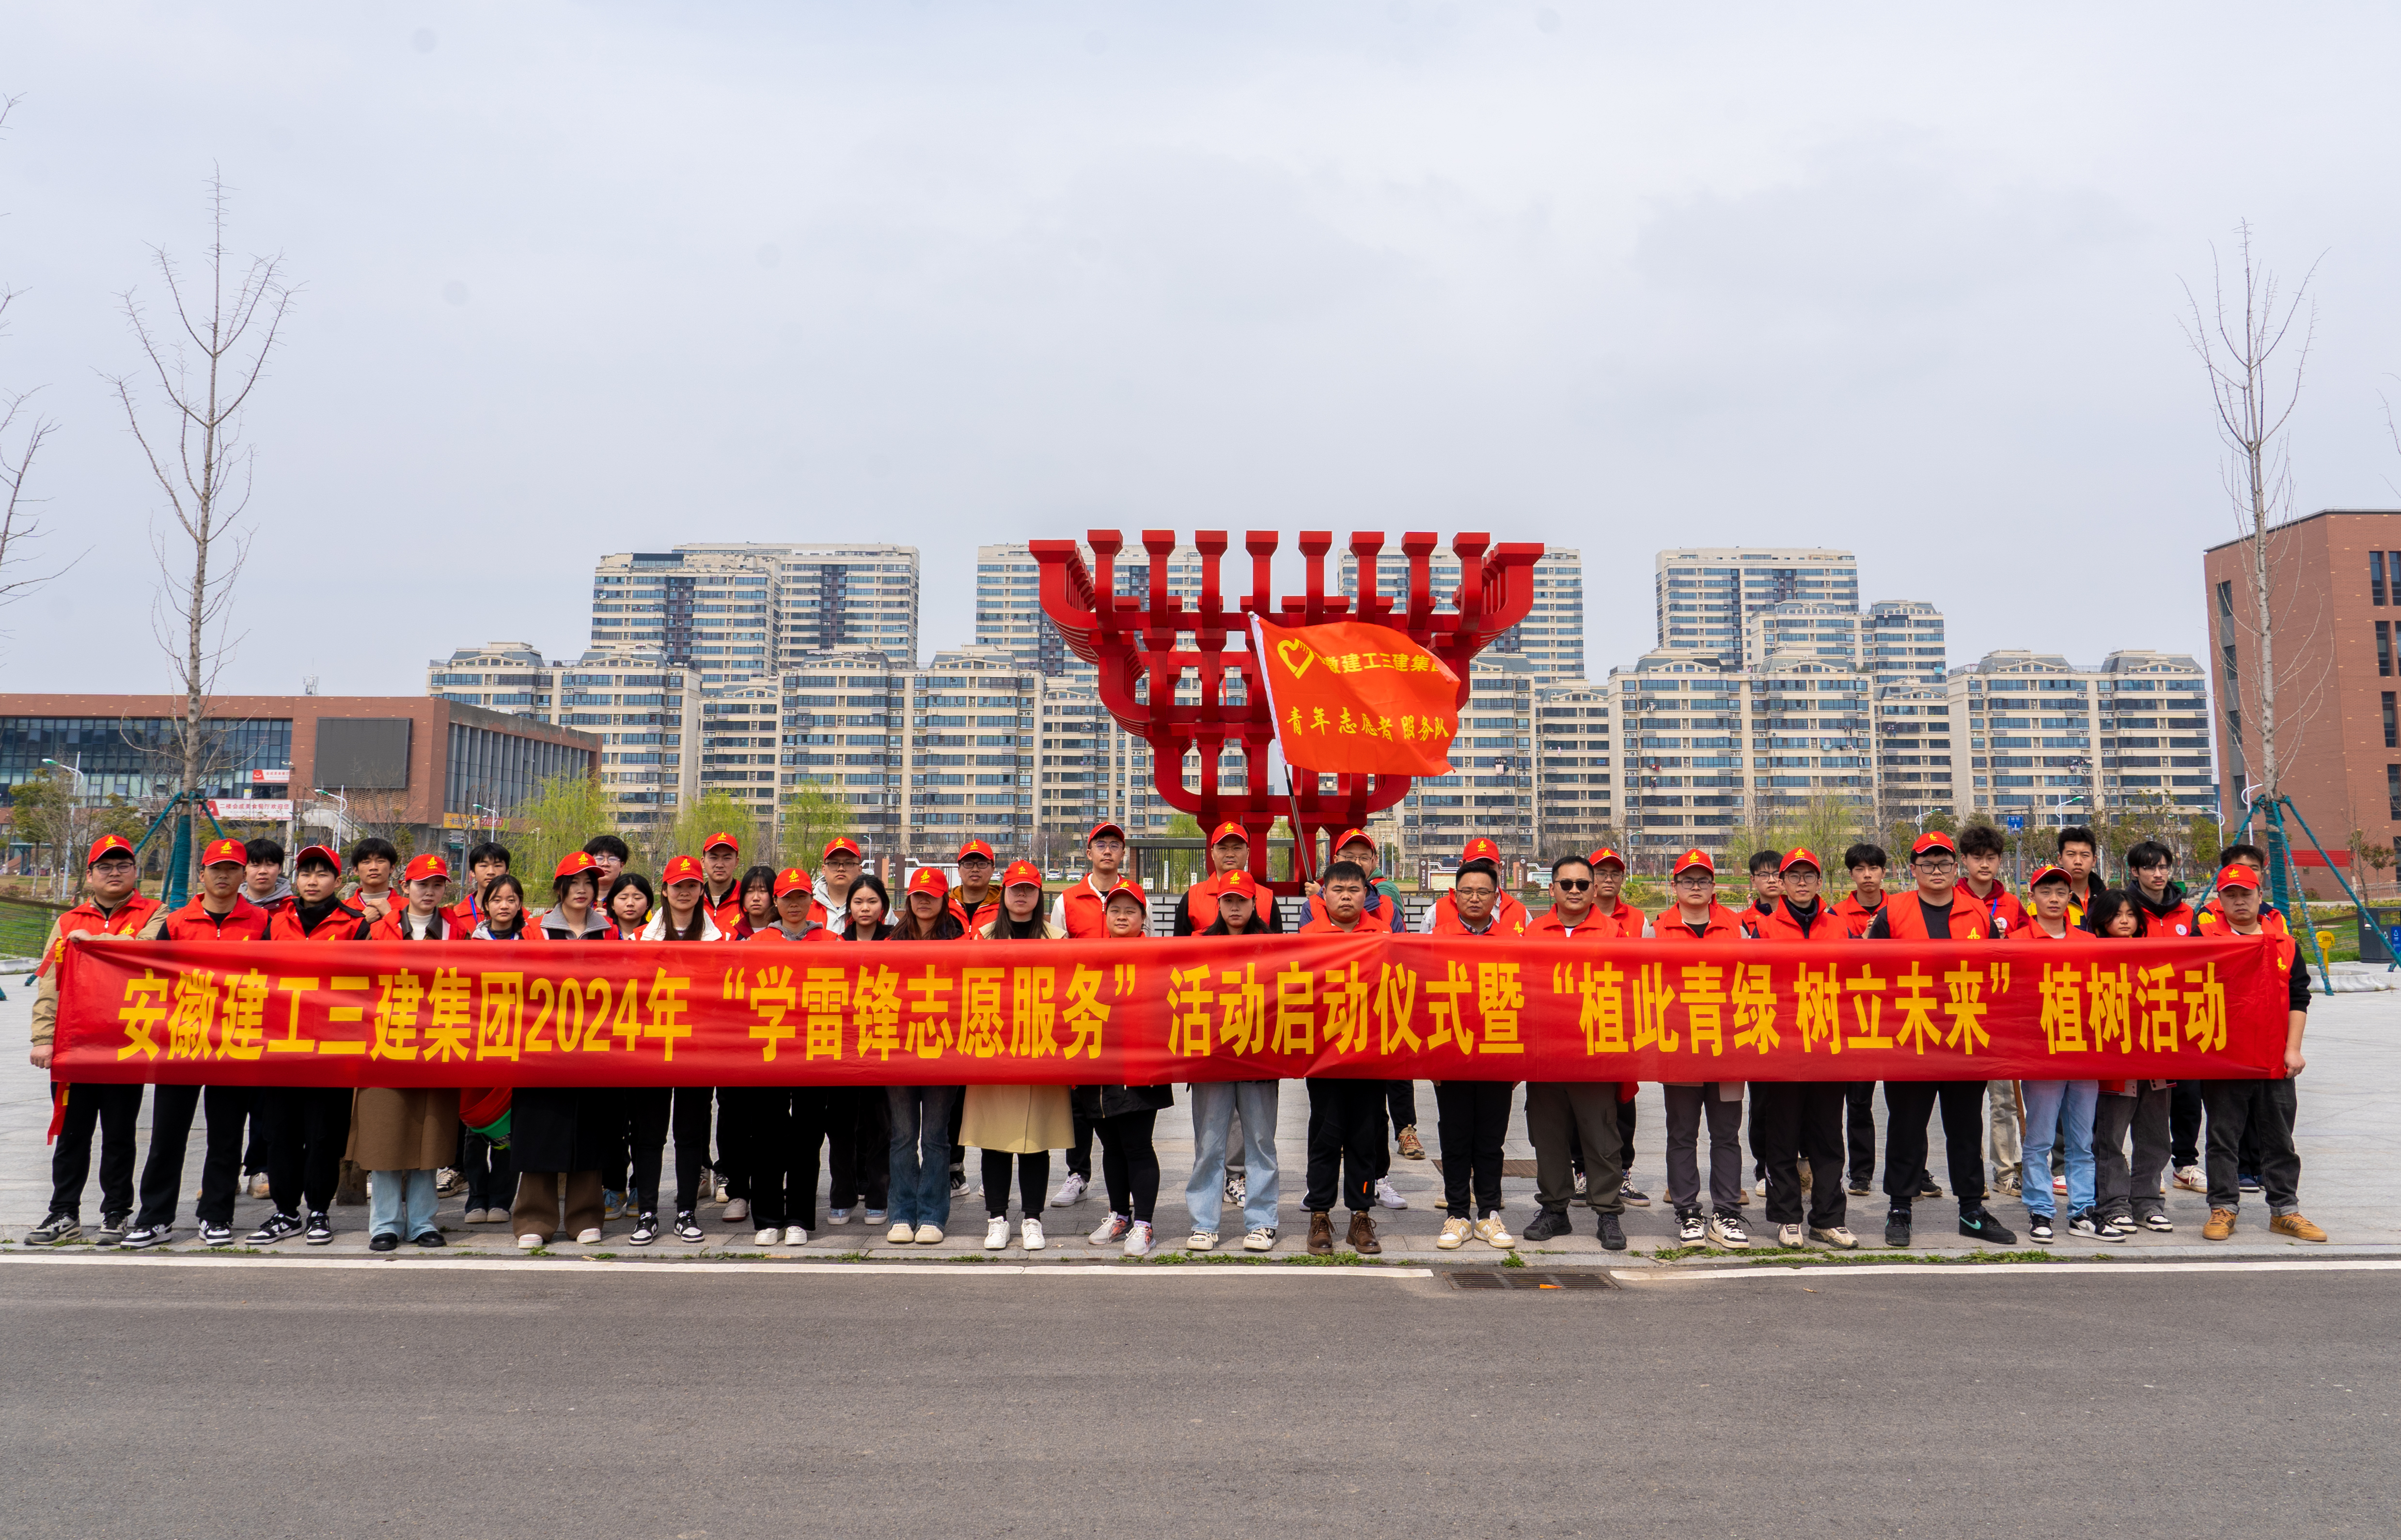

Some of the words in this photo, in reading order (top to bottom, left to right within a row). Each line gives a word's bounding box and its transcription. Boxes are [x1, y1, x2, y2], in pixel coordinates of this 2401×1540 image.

[1314, 652, 1439, 674] 徽建工三建集
[1287, 706, 1449, 742] 青年志愿者服务队
[117, 967, 692, 1063] 安徽建工三建集团2024年
[723, 964, 1136, 1062] “学雷锋志愿服务”
[1167, 960, 1525, 1057] 活动启动仪式暨
[2039, 962, 2227, 1055] 植树活动
